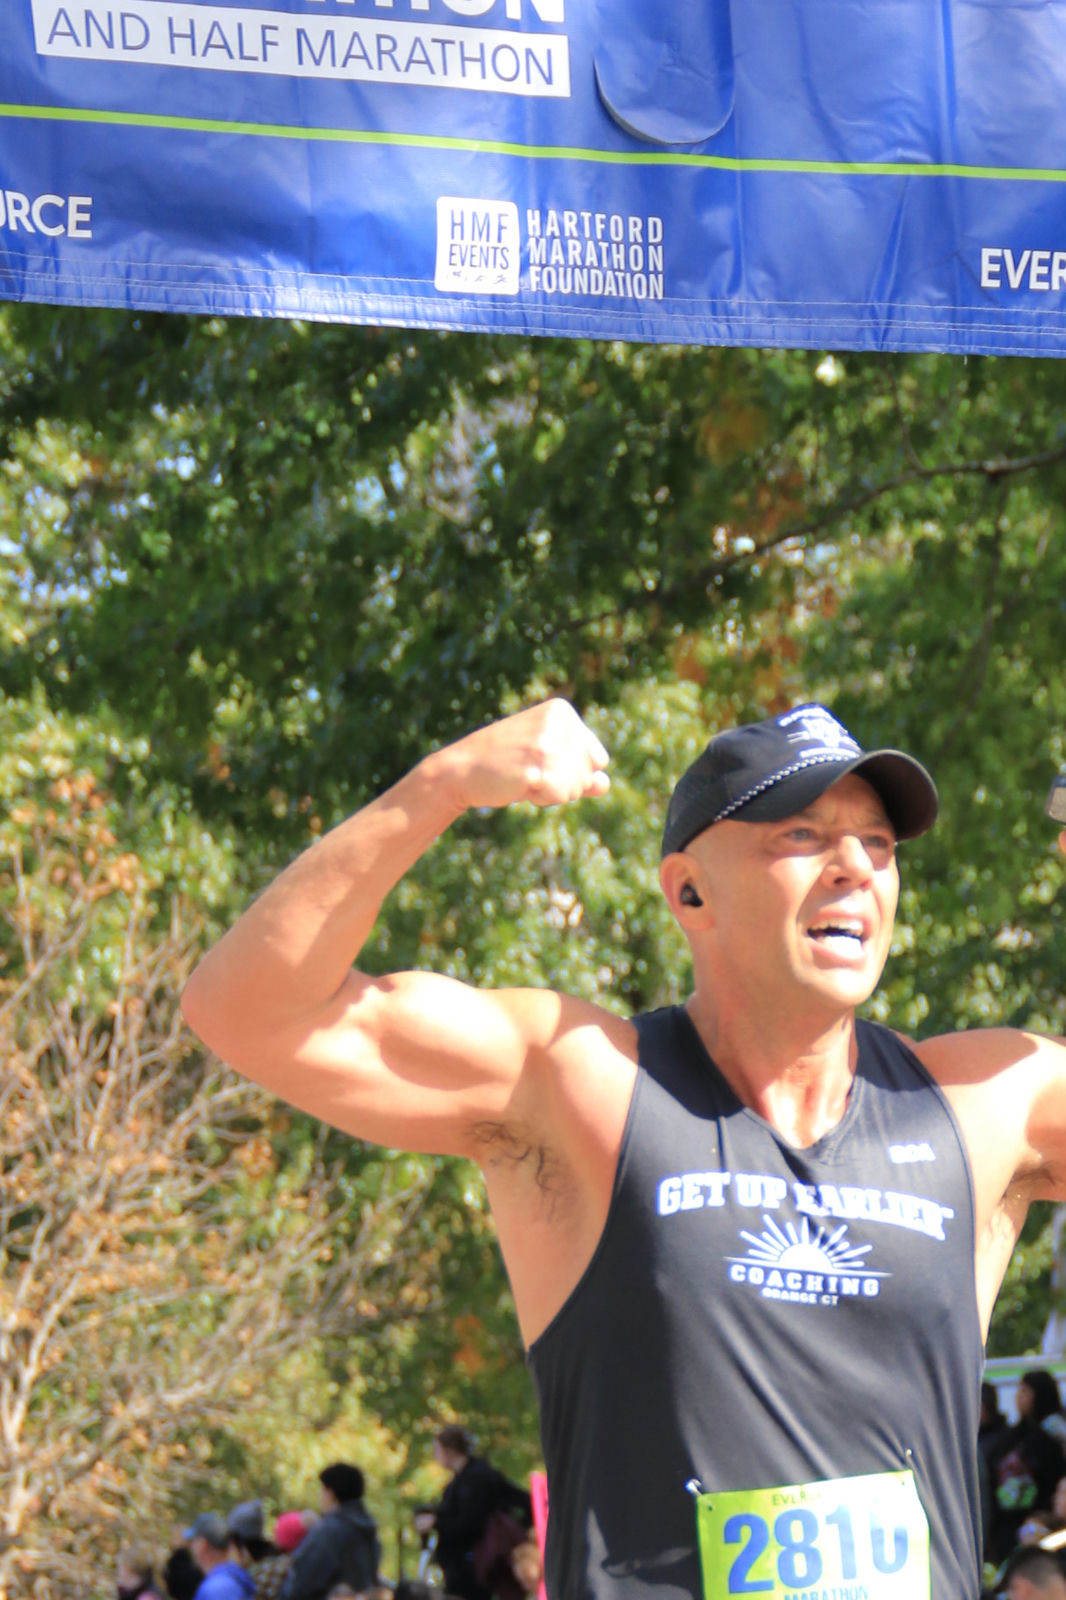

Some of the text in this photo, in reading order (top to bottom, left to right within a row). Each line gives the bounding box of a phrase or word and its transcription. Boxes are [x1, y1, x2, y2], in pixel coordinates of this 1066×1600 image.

[47, 7, 554, 86] AND HALF MARATHON
[450, 209, 509, 244] HMF
[527, 208, 663, 243] HARTFORD
[449, 243, 510, 270] EVENTS
[528, 237, 664, 272] MARATHON
[529, 265, 664, 300] FOUNDATION
[657, 1171, 947, 1241] GET UP EARLIER
[729, 1263, 880, 1297] COACHING
